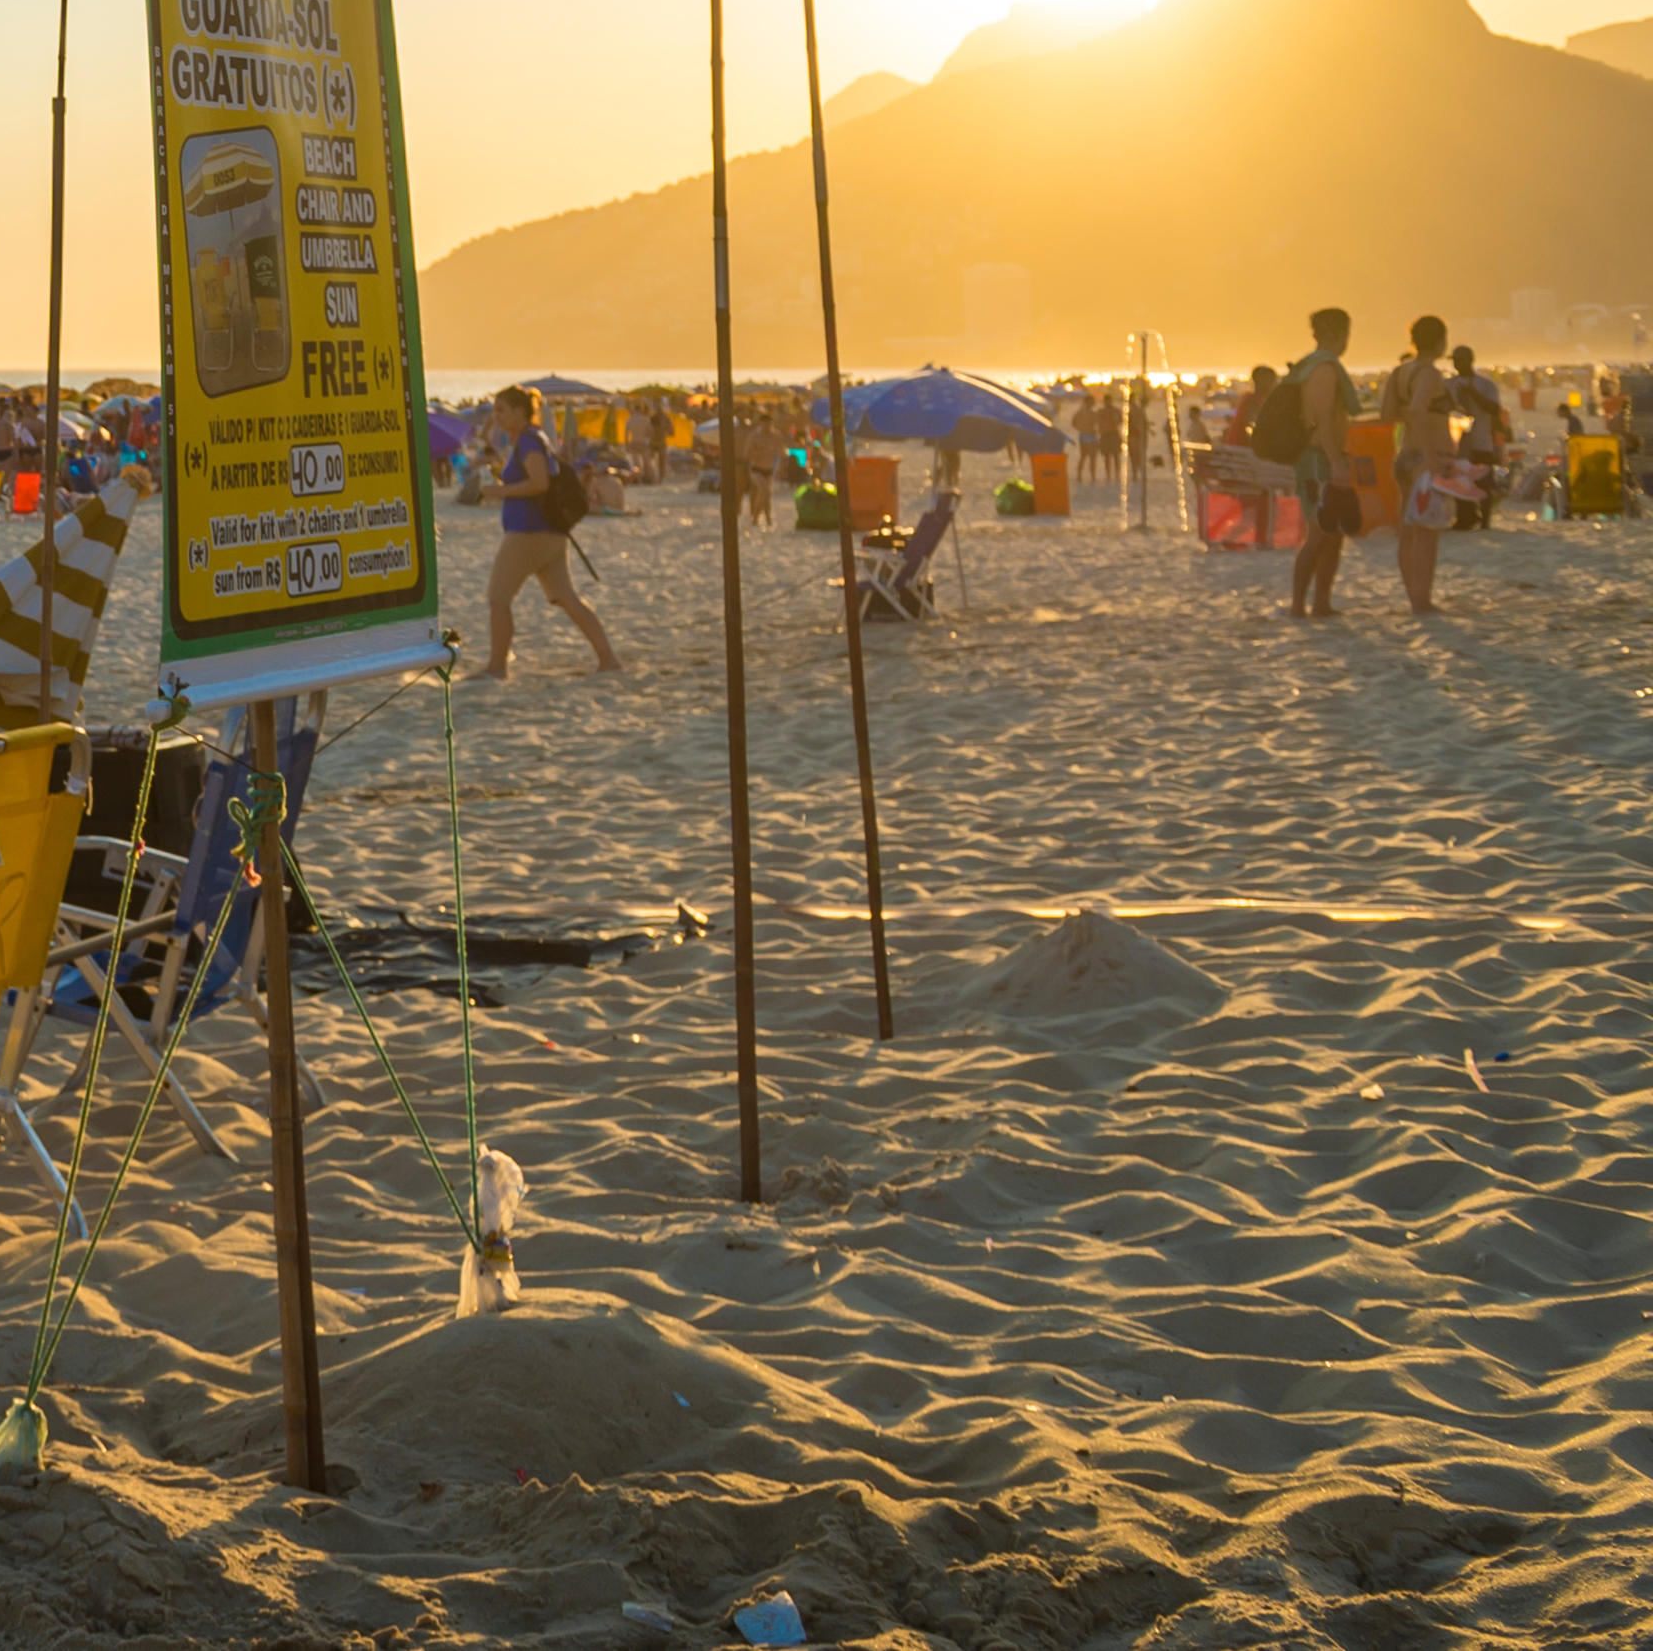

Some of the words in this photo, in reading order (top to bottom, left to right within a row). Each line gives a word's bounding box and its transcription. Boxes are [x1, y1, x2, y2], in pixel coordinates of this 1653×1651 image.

[171, 48, 319, 116] GRATUITOS
[153, 45, 167, 176] BARRACA
[304, 137, 356, 177] BEACH
[297, 188, 340, 222] CHAIR
[342, 192, 375, 224] AND
[301, 237, 375, 270] UMBRELLA
[163, 263, 174, 376] MIRIAM
[326, 286, 358, 324] SUN
[302, 339, 369, 399] FREE
[209, 414, 244, 445] VÁLIDO
[258, 416, 276, 442] KIT
[292, 413, 337, 440] CADEIRAS
[350, 408, 401, 435] GUARDA-SOL
[211, 465, 220, 491] A
[220, 462, 259, 490] PARTIR
[261, 461, 276, 487] DE
[359, 450, 399, 476] CONSUMO
[211, 516, 238, 546] Valid
[239, 516, 257, 542] for
[259, 513, 276, 540] kit
[299, 510, 306, 536] 2
[308, 506, 342, 534] chairs
[343, 505, 359, 530] and
[367, 499, 408, 528] umbrella
[214, 572, 235, 595] sun
[236, 564, 263, 591] from
[266, 559, 282, 589] R$
[349, 544, 405, 578] consumption
